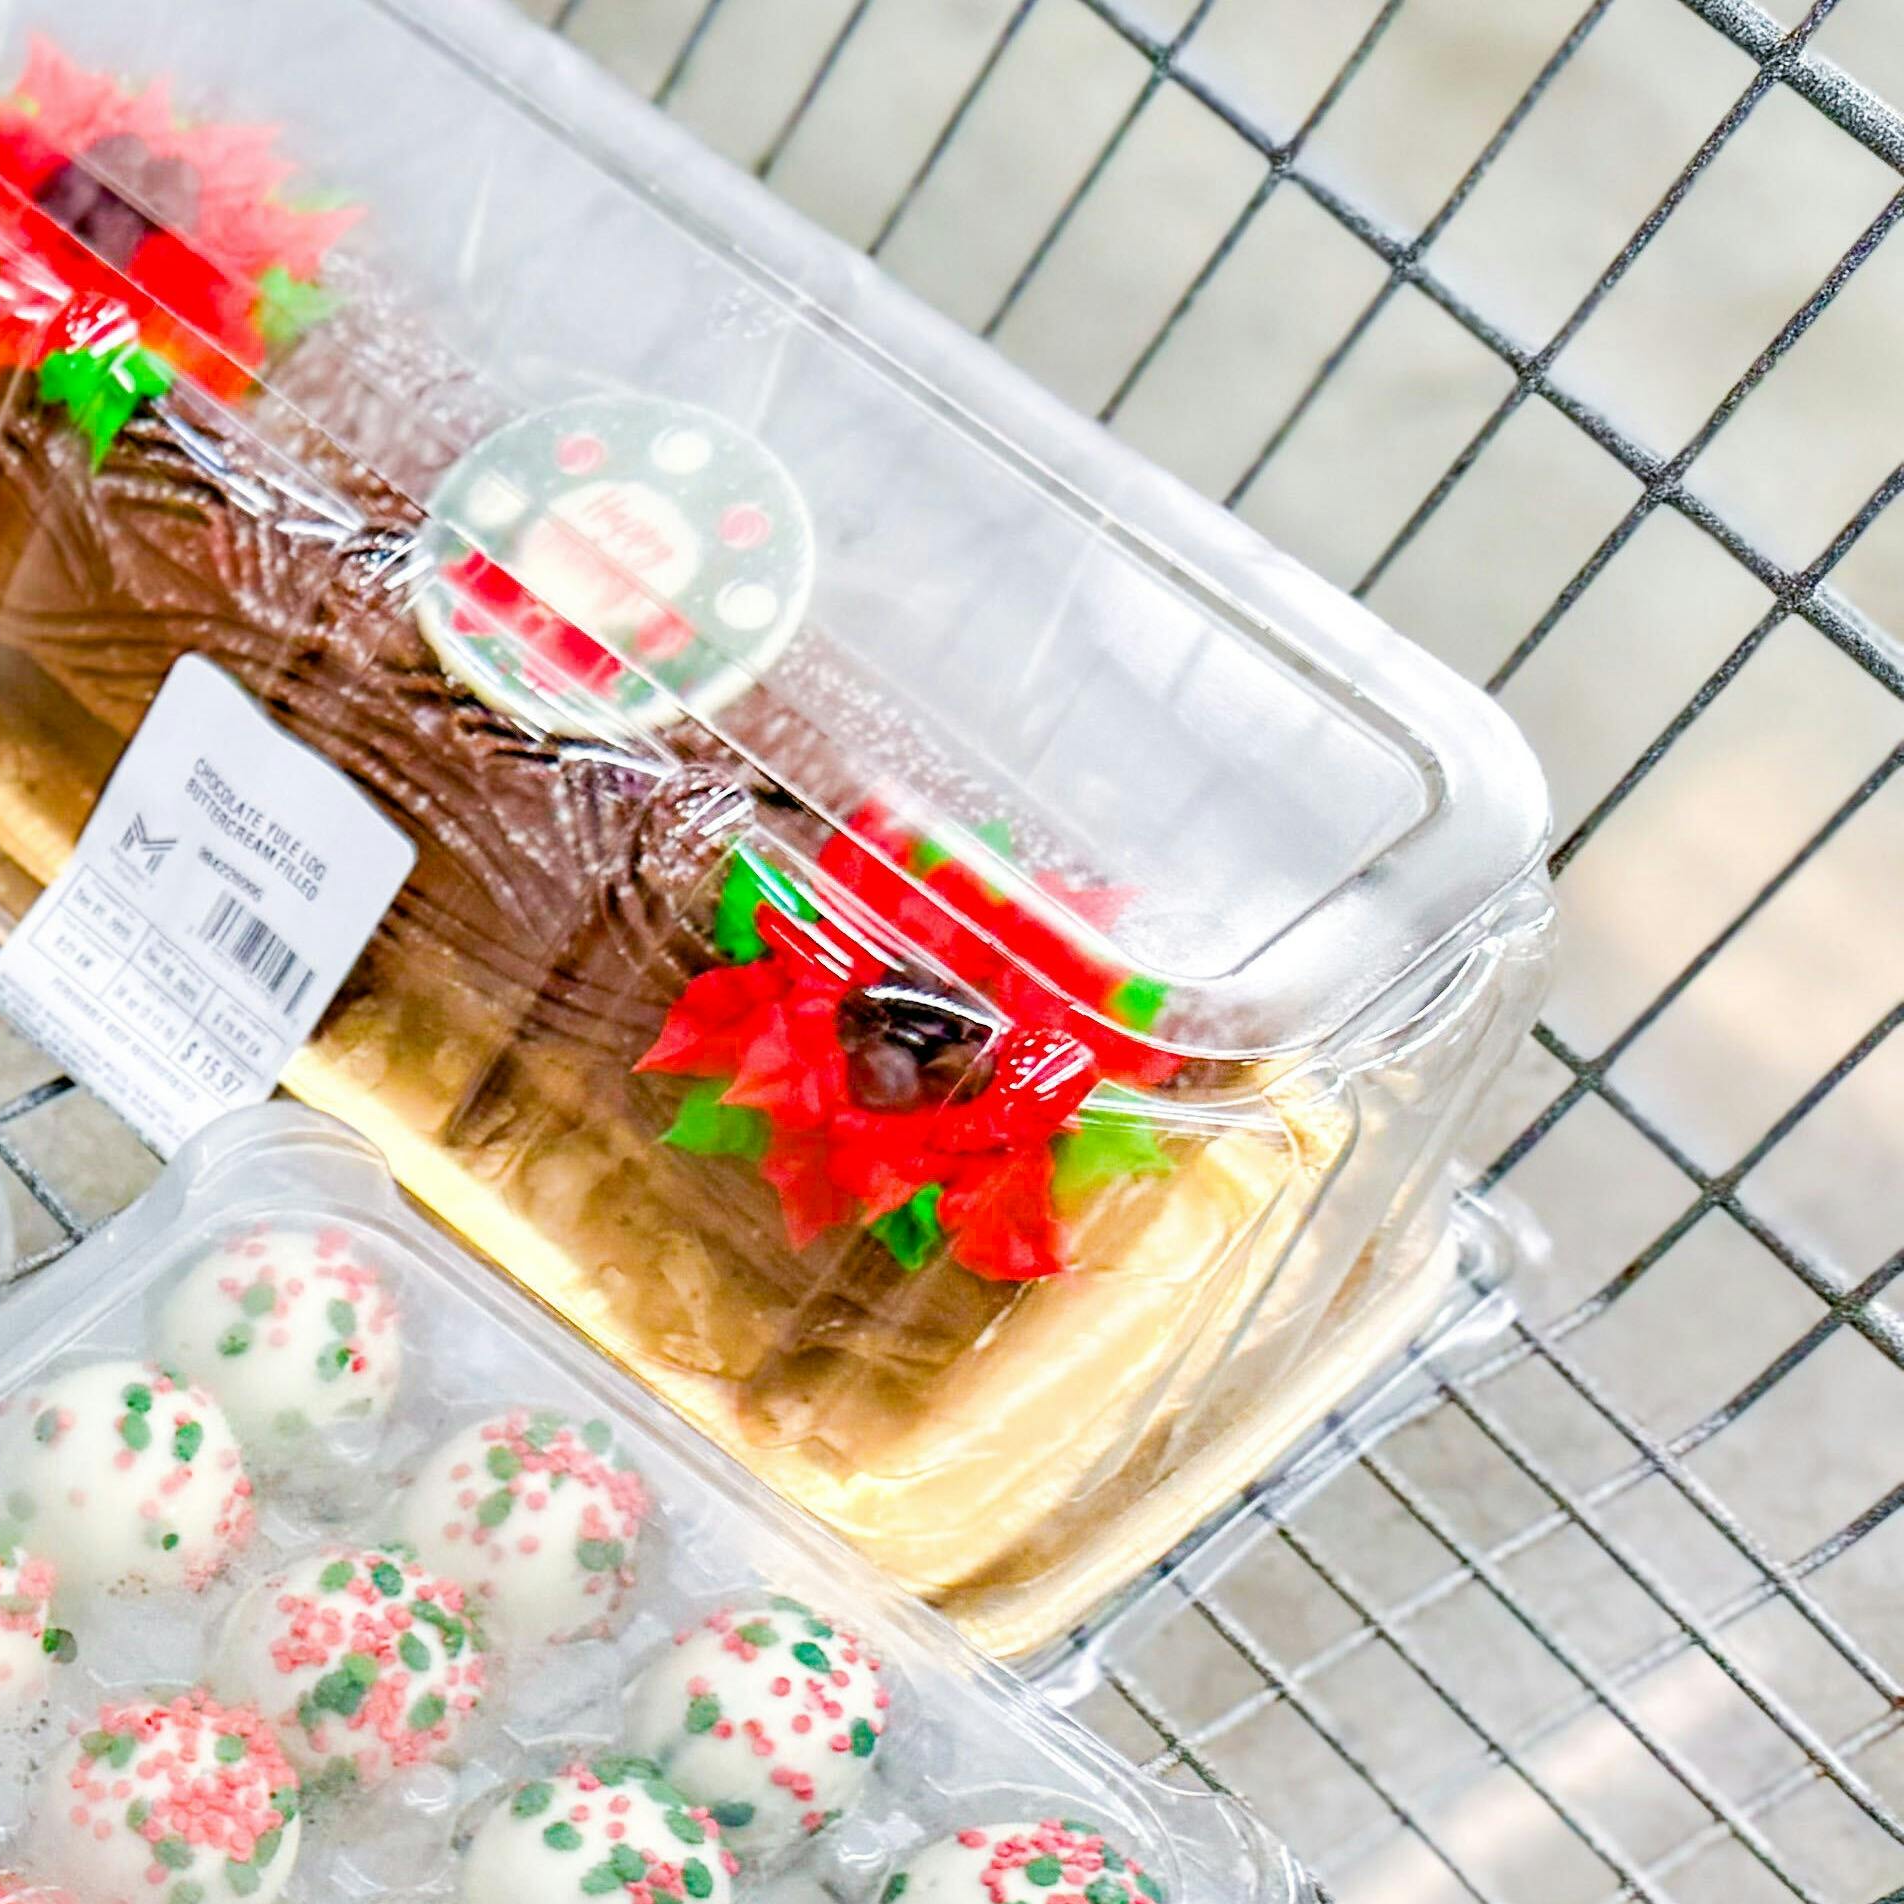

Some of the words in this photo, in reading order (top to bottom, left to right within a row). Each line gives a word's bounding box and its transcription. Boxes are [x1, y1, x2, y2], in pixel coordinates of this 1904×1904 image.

[186, 778, 277, 861] BUTTERCREAM
[276, 857, 318, 901] FILLED
[195, 758, 263, 827] CHOCOLATE
[264, 821, 302, 858] YULE
[298, 850, 328, 882] LOG
[180, 1040, 199, 1062] $
[198, 1054, 244, 1096] 15.97
